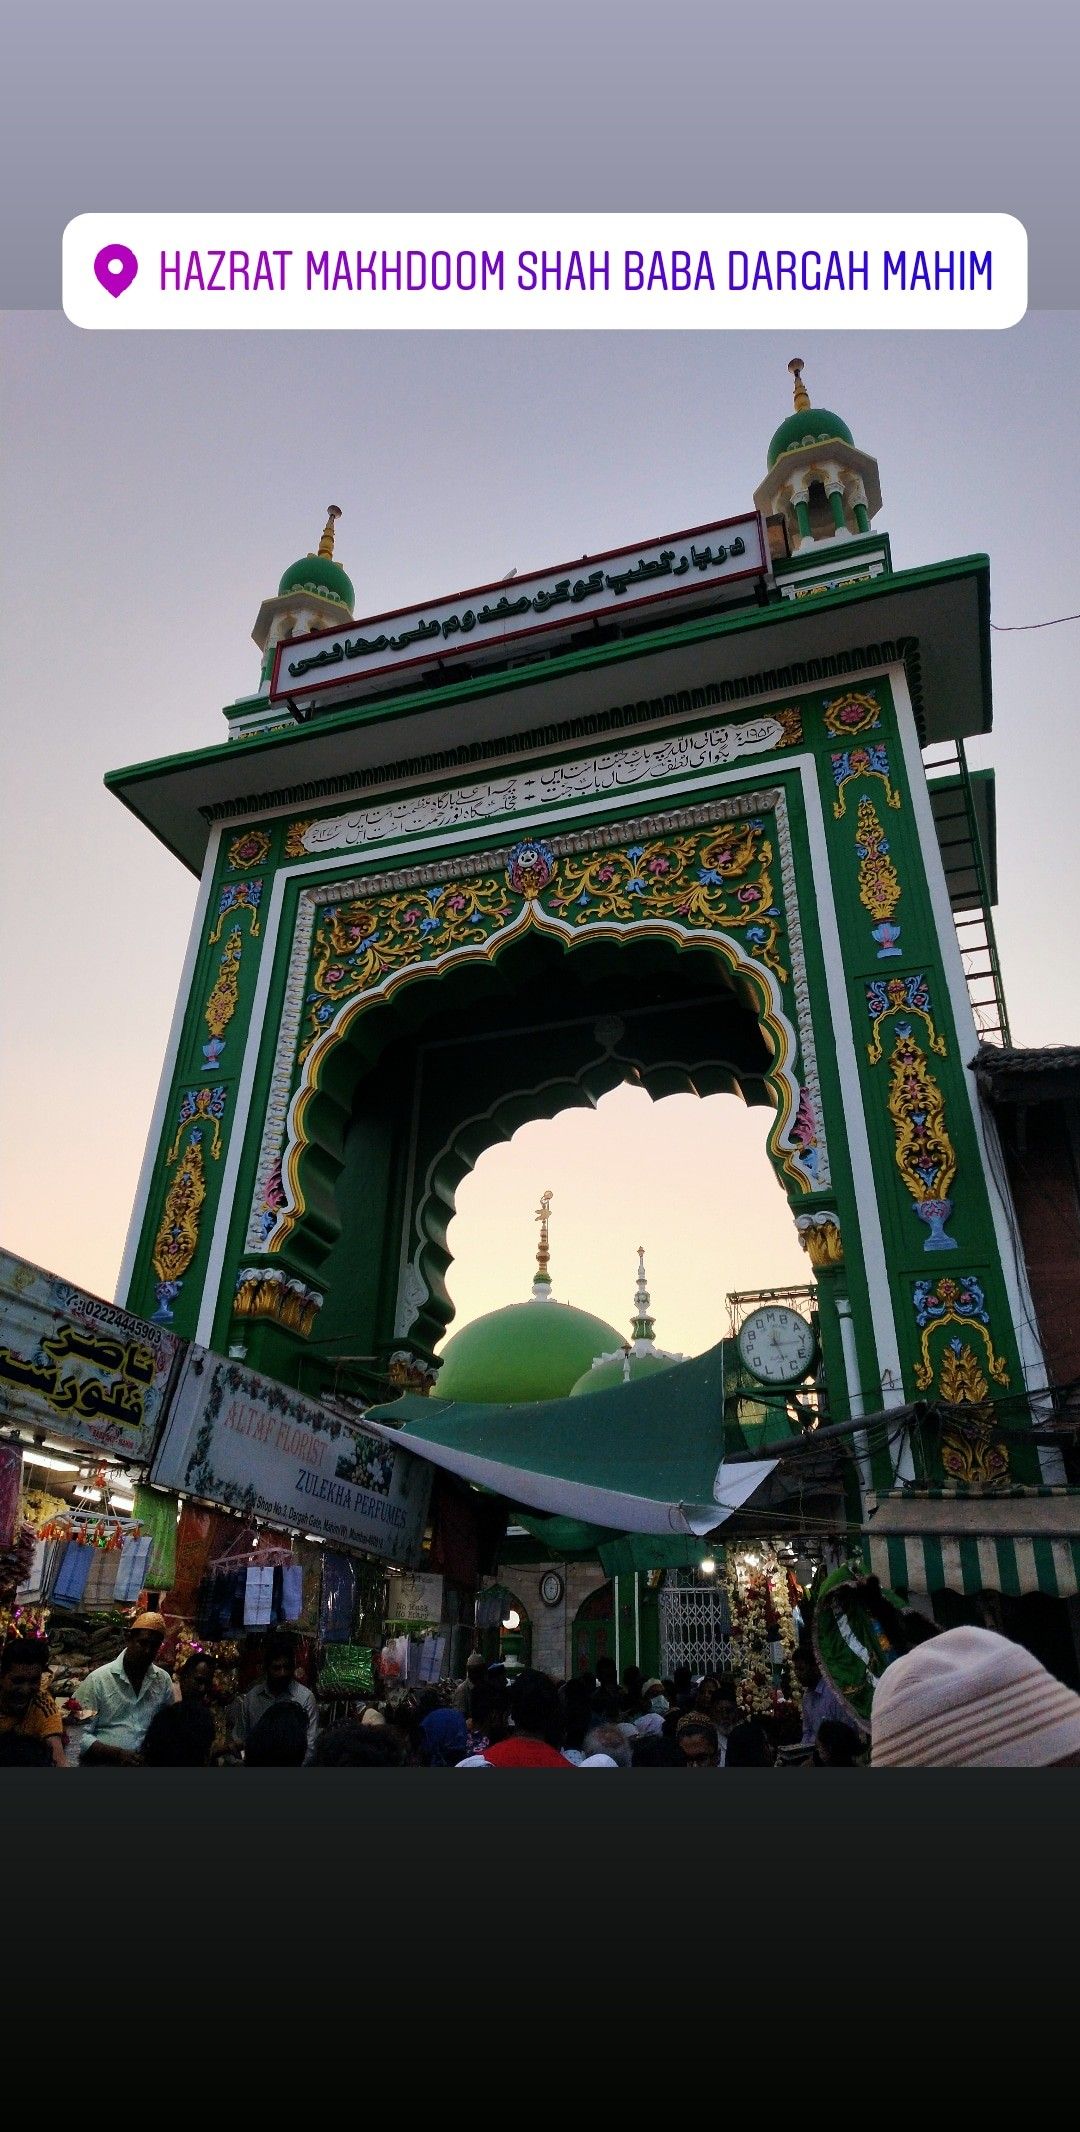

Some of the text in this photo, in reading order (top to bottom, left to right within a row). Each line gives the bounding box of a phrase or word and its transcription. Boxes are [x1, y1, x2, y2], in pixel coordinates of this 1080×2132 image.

[747, 1312, 807, 1347] BOMBAY
[745, 1344, 807, 1377] POLICE
[276, 1422, 329, 1468] FLORIST
[256, 1496, 272, 1514] Shop
[295, 1468, 407, 1529] ZULEKHA PERFUMES
